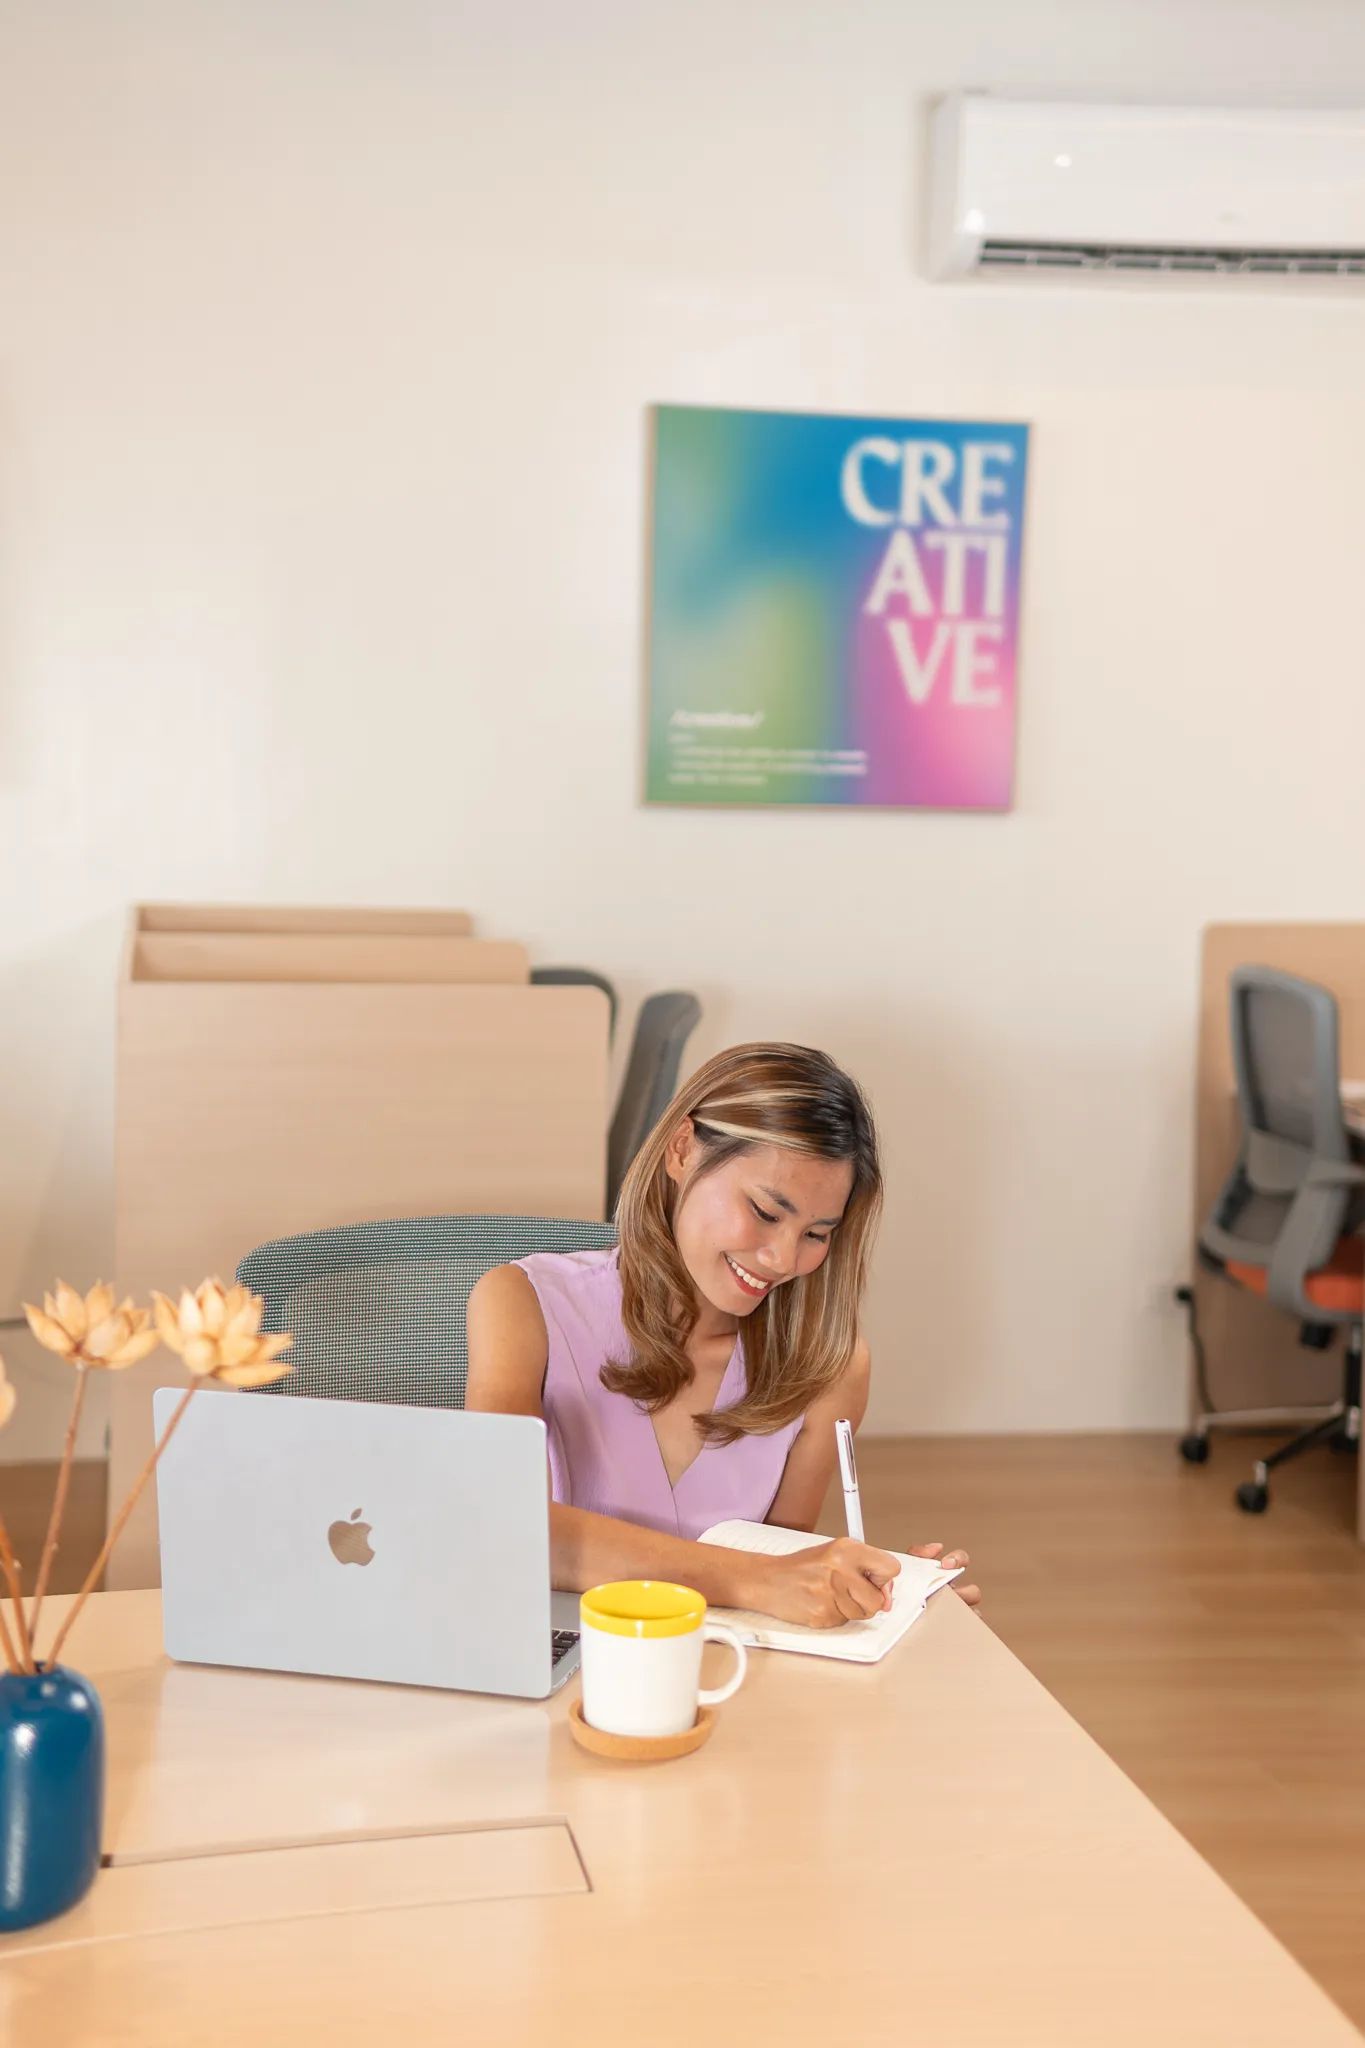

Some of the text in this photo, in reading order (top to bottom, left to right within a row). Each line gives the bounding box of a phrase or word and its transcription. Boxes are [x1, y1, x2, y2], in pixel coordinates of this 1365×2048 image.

[841, 436, 1014, 529] CRE
[865, 528, 1007, 617] ATI
[886, 619, 1004, 707] VE
